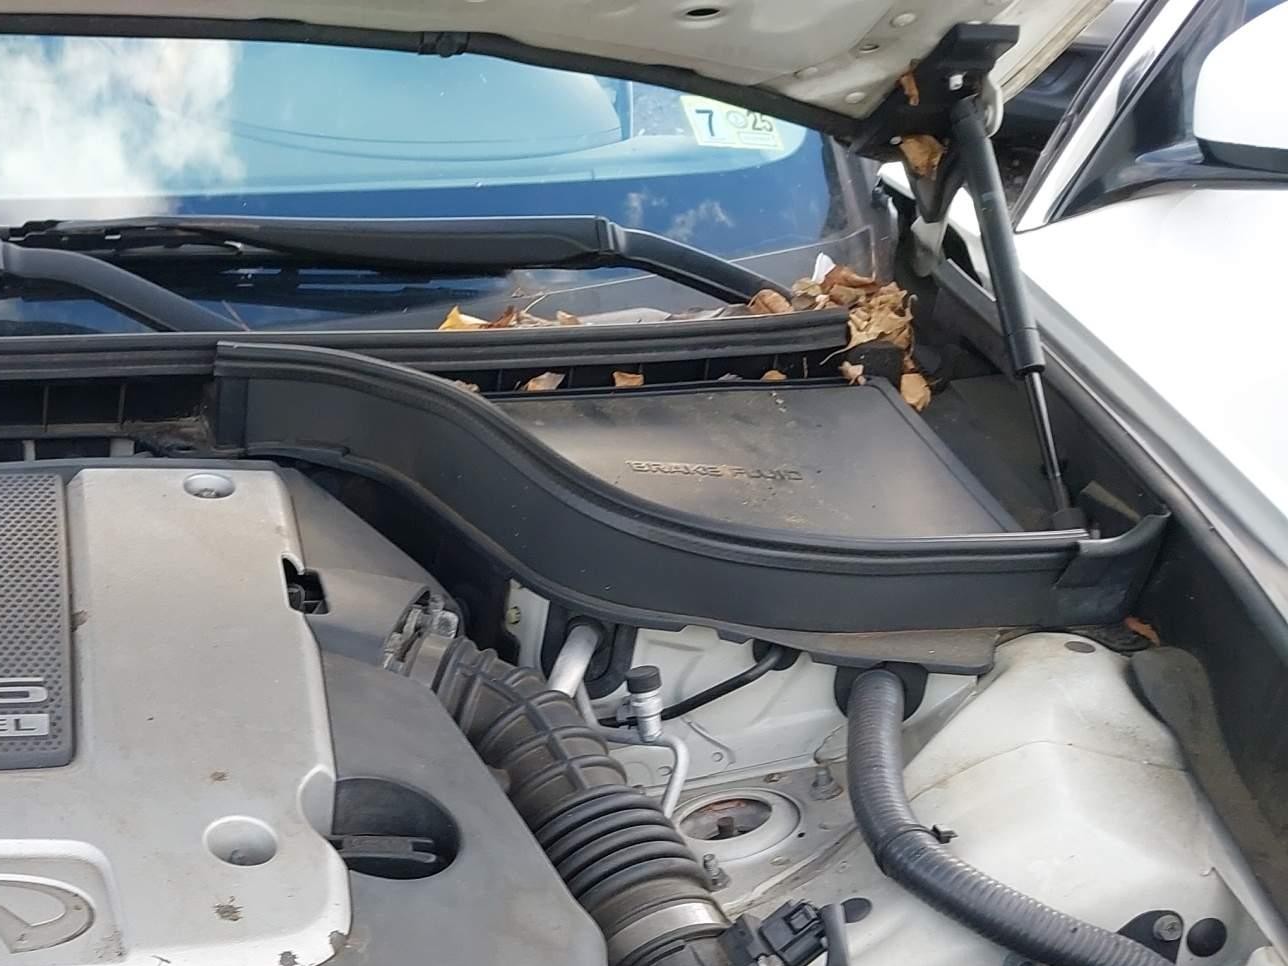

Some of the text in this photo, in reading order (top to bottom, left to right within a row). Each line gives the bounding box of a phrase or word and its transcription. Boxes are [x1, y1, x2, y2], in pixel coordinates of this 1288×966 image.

[695, 108, 715, 137] 7
[627, 461, 804, 481] BRAKE FLUID
